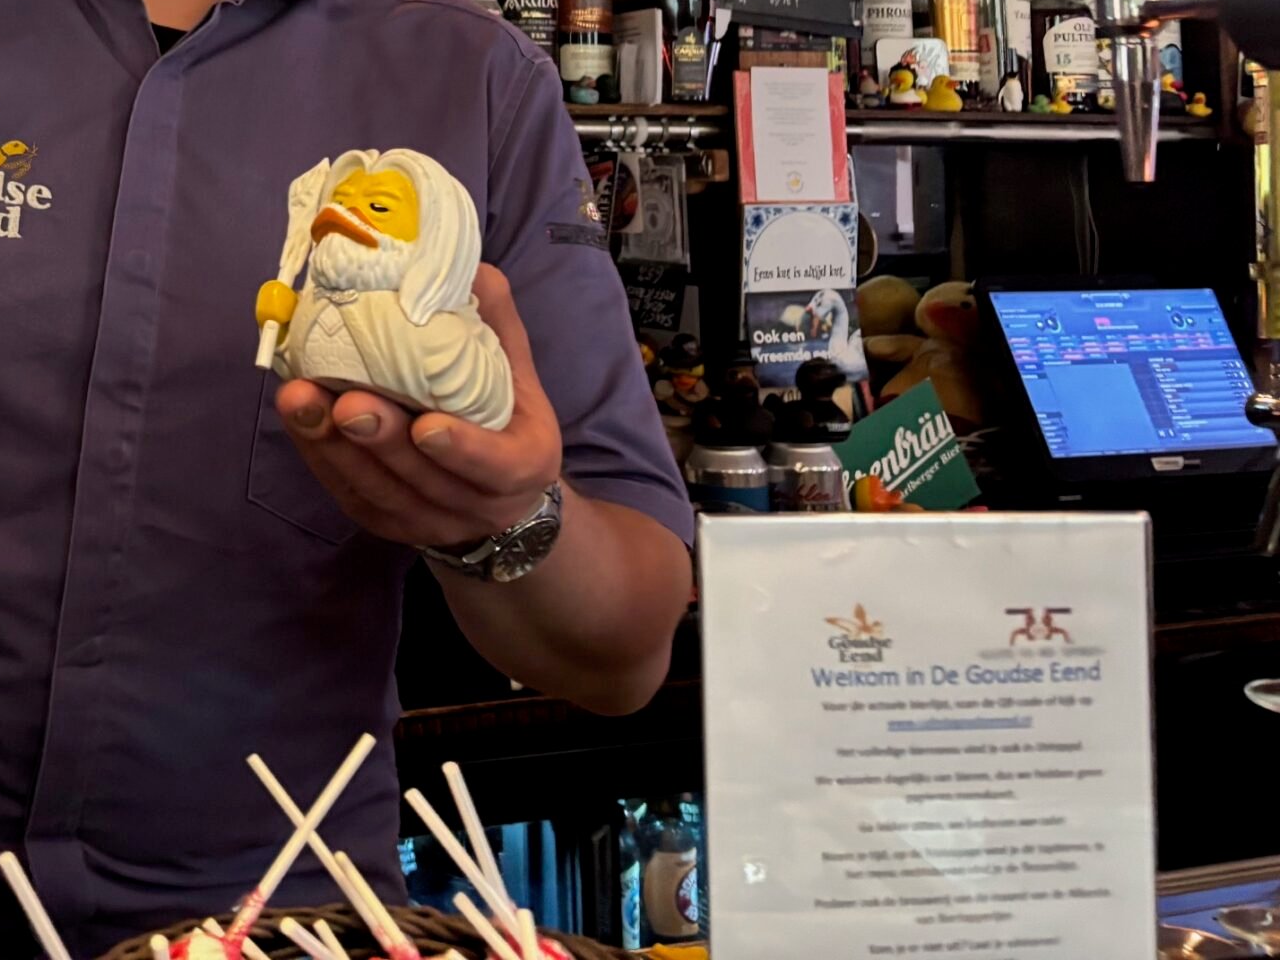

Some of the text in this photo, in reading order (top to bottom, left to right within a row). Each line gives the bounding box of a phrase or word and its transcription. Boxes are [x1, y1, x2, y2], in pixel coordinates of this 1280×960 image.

[793, 265, 801, 279] is
[803, 264, 827, 281] altijd
[753, 328, 805, 344] Ook een
[839, 648, 883, 663] Eend
[811, 660, 1101, 688] Welkom in De Goudse Eend
